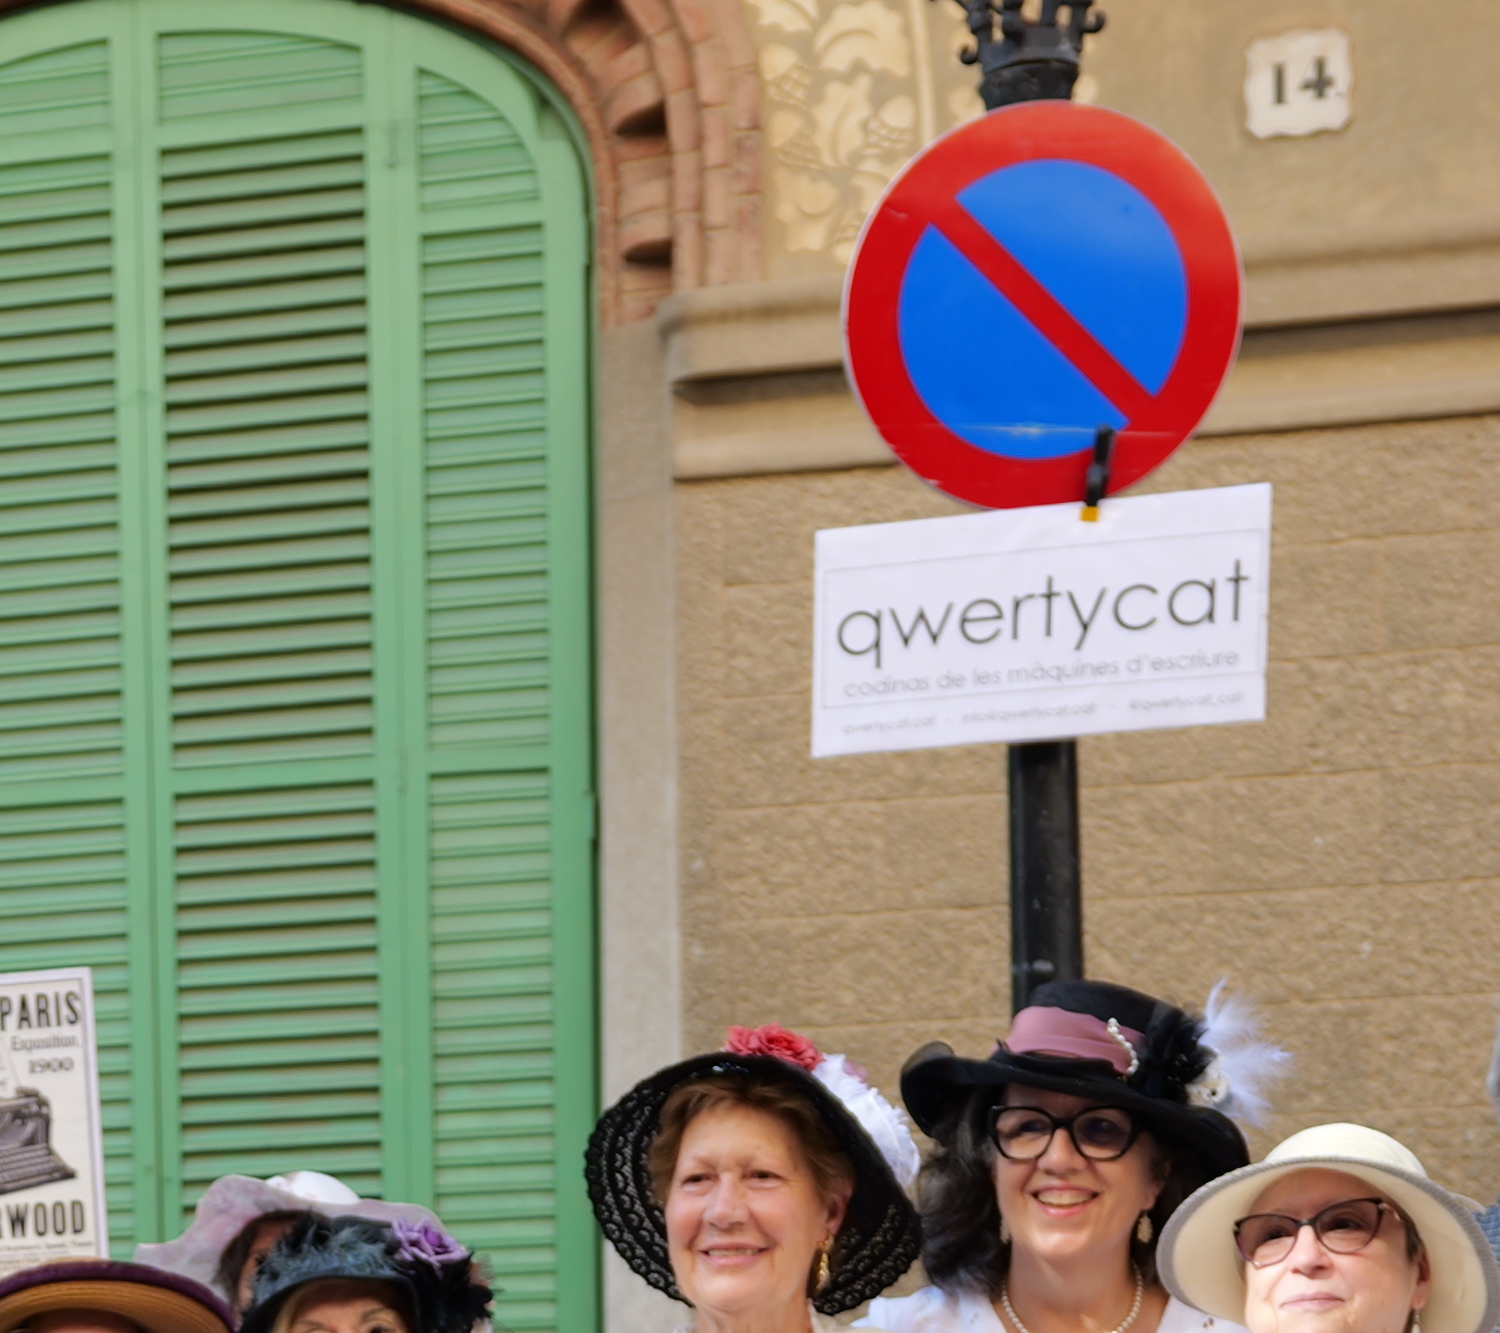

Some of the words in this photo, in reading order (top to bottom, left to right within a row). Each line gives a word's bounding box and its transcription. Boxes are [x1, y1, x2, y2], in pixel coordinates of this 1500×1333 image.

[836, 558, 1249, 670] qwertycat
[936, 668, 965, 690] de
[972, 665, 1001, 687] les
[1007, 658, 1119, 686] màquines
[1126, 648, 1241, 675] d'escriure
[28, 1056, 75, 1074] 1900
